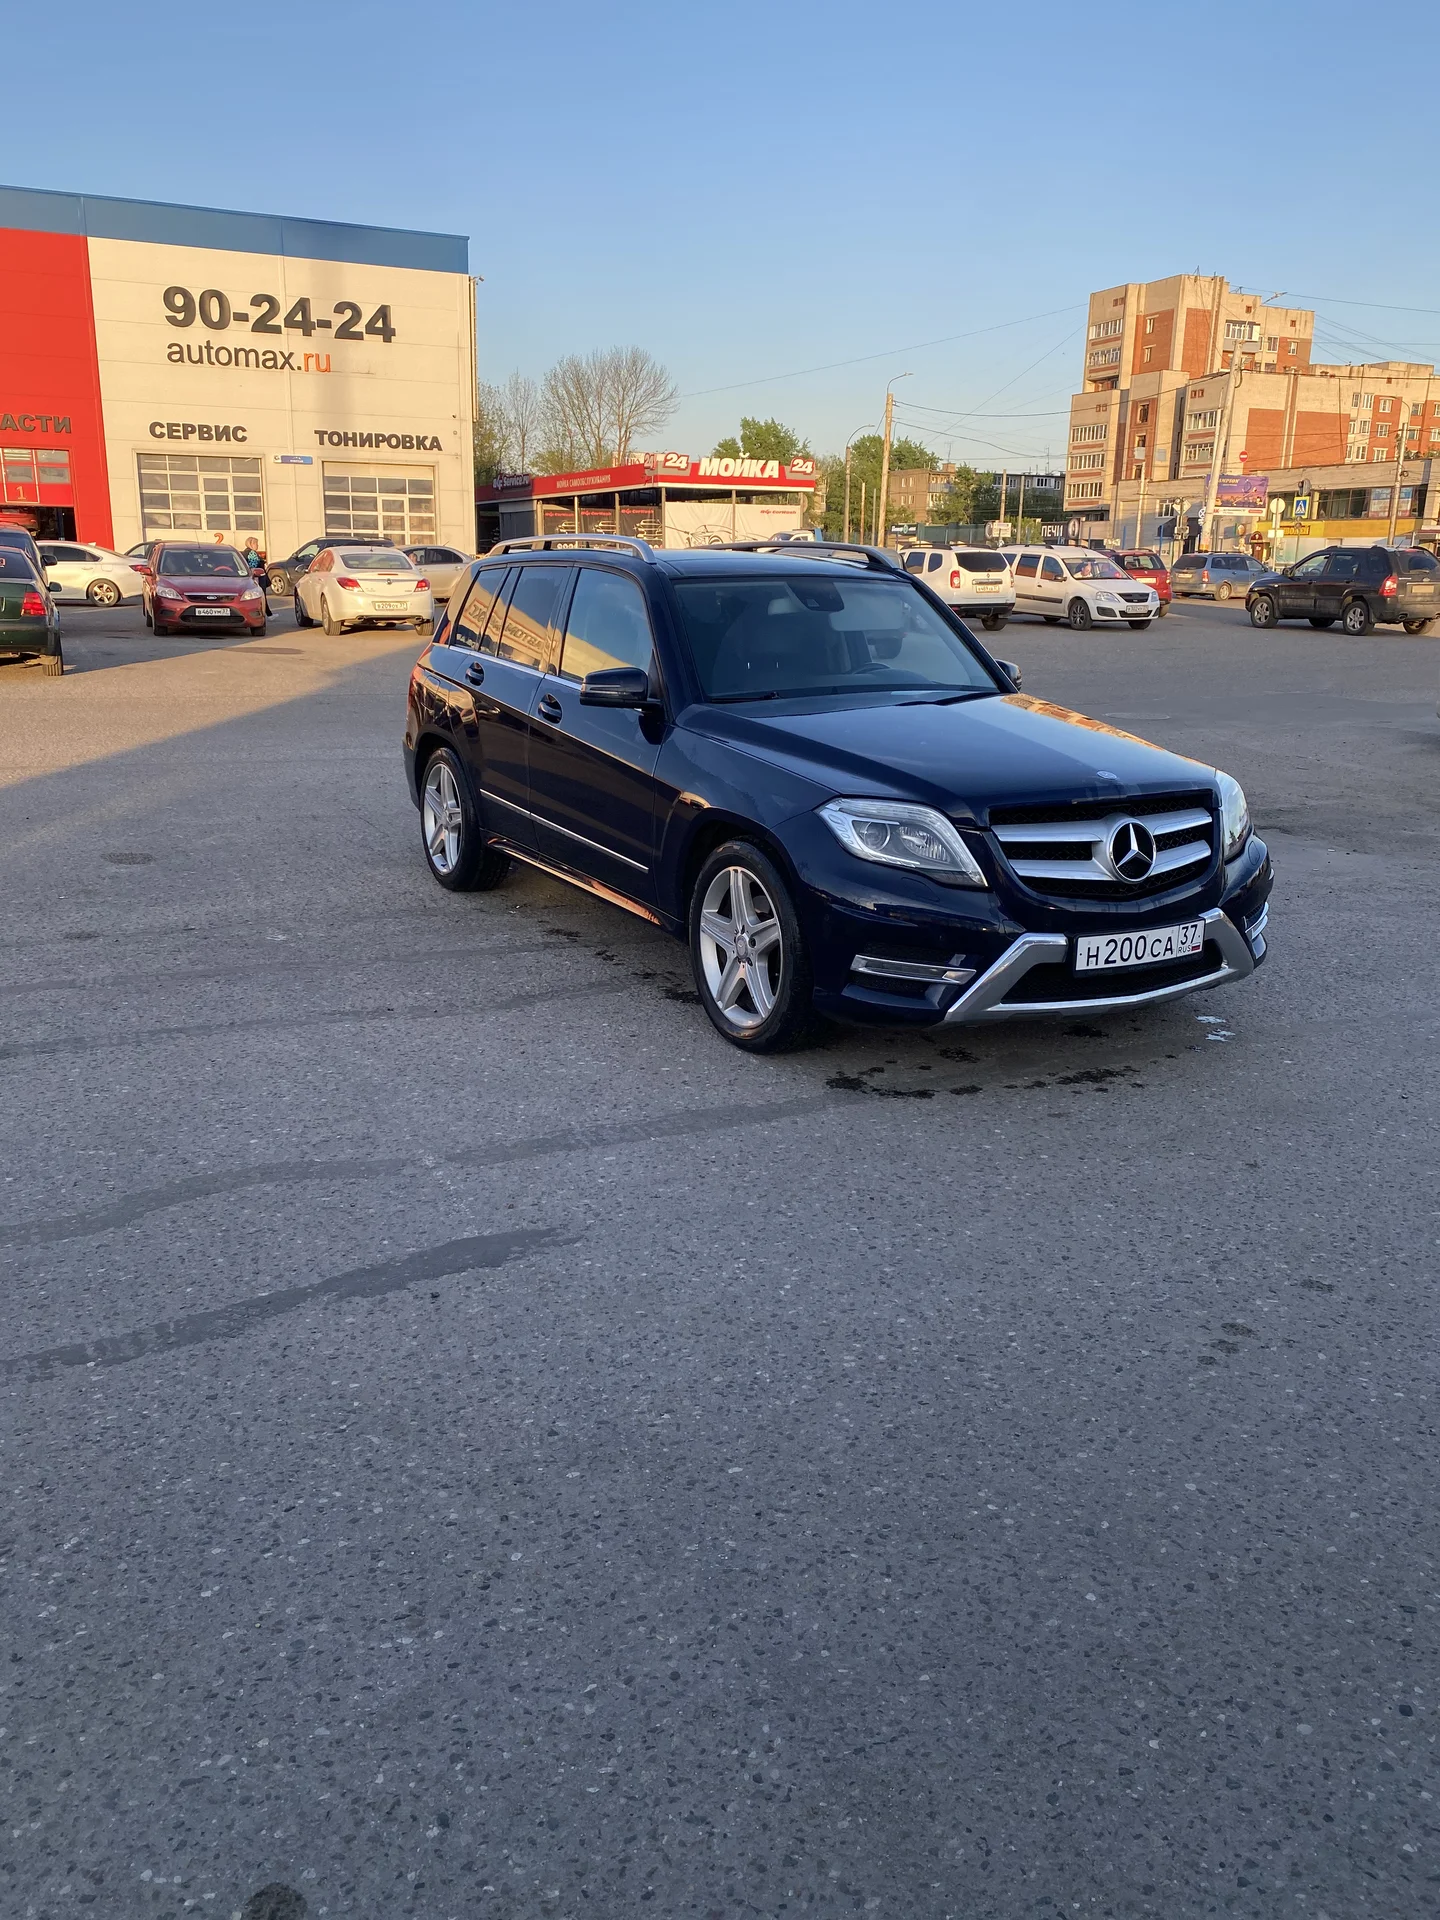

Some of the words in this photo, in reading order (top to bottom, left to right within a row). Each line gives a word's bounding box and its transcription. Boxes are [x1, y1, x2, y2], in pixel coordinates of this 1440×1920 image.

[163, 286, 396, 343] 90-24-24
[166, 340, 331, 373] automax.ru
[149, 421, 248, 442] СЕРВИС
[314, 430, 443, 451] ТОНИРОВКА
[665, 453, 689, 469] 24
[698, 452, 780, 479] МОЙКА
[791, 458, 814, 474] 24
[16, 486, 26, 499] 1
[1041, 525, 1063, 537] ПЕЧИ
[1086, 935, 1174, 967] Н200СА
[1180, 924, 1198, 946] 37
[1178, 945, 1192, 954] RUS
